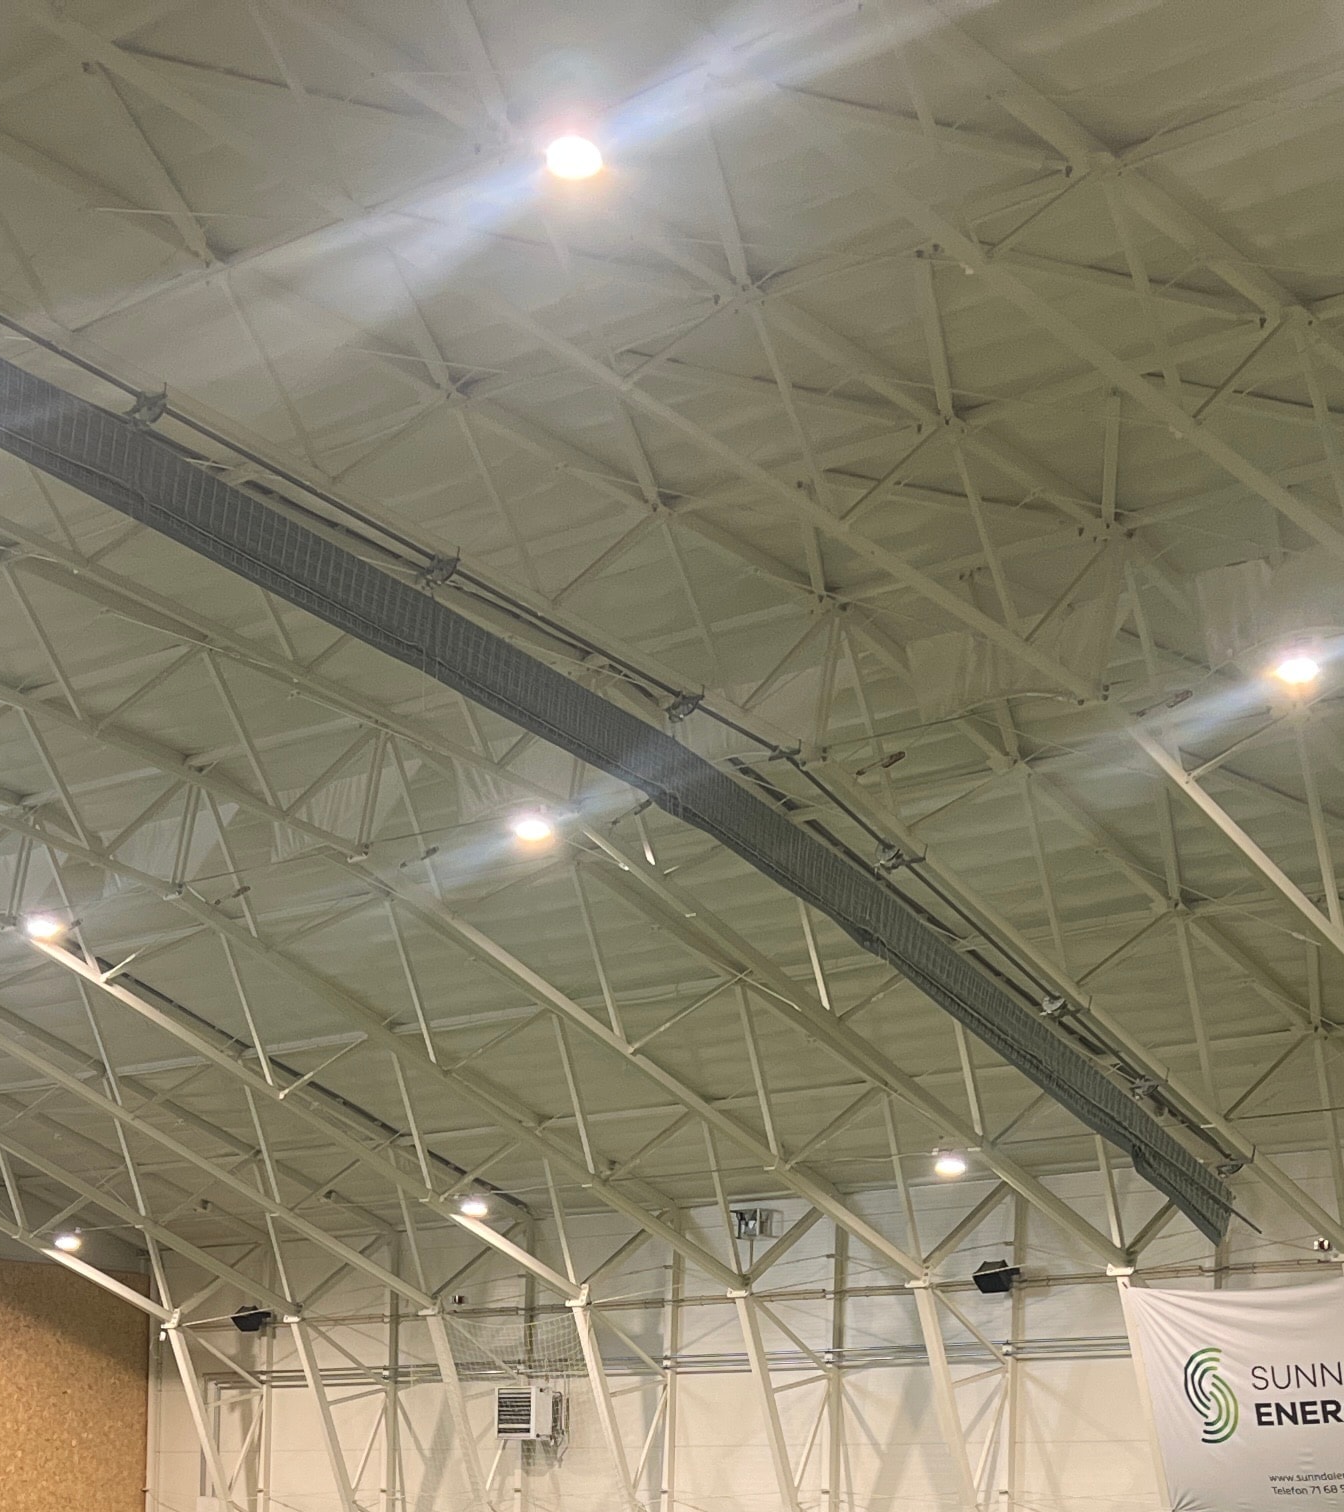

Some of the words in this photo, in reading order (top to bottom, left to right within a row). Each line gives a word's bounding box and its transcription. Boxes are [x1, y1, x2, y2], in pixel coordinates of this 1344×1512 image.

[1271, 1486, 1308, 1495] Telefon
[1310, 1485, 1322, 1495] 71
[1323, 1484, 1338, 1494] 68
